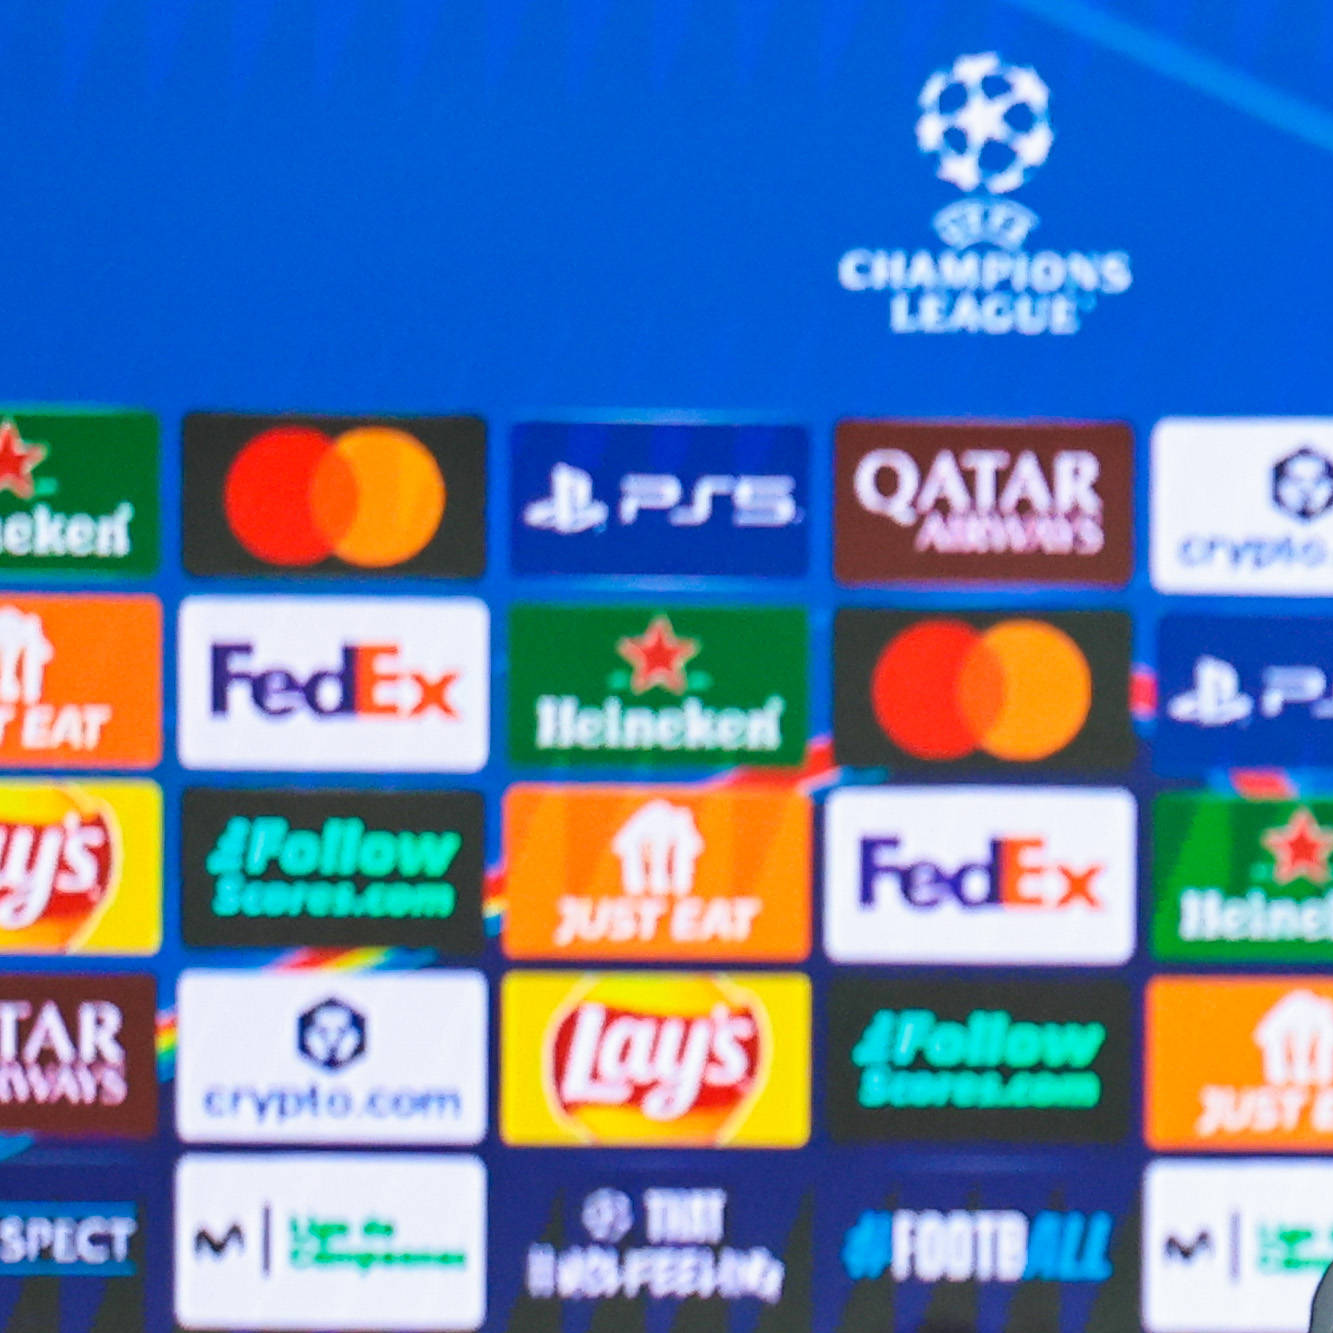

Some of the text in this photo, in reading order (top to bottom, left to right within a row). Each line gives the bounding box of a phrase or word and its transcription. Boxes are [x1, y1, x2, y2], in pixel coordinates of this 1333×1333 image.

[839, 250, 1132, 293] CHAMPIONS
[891, 292, 1080, 335] LEAGUE
[620, 475, 796, 526] PS5
[855, 450, 1100, 528] QATAR
[0, 504, 131, 556] eken
[210, 641, 456, 720] FedEx
[21, 704, 112, 750] EAT
[537, 696, 781, 750] Heineken
[0, 812, 106, 930] y's
[858, 835, 1100, 912] FedEx
[555, 895, 762, 947] JUST EAT
[0, 1002, 123, 1064] TAR
[560, 1003, 755, 1120] Lay's
[202, 1082, 462, 1123] crypto.com
[1196, 1085, 1308, 1137] JUST
[0, 1216, 135, 1263] SPECT
[843, 1209, 1112, 1282] #FOOTBALL
